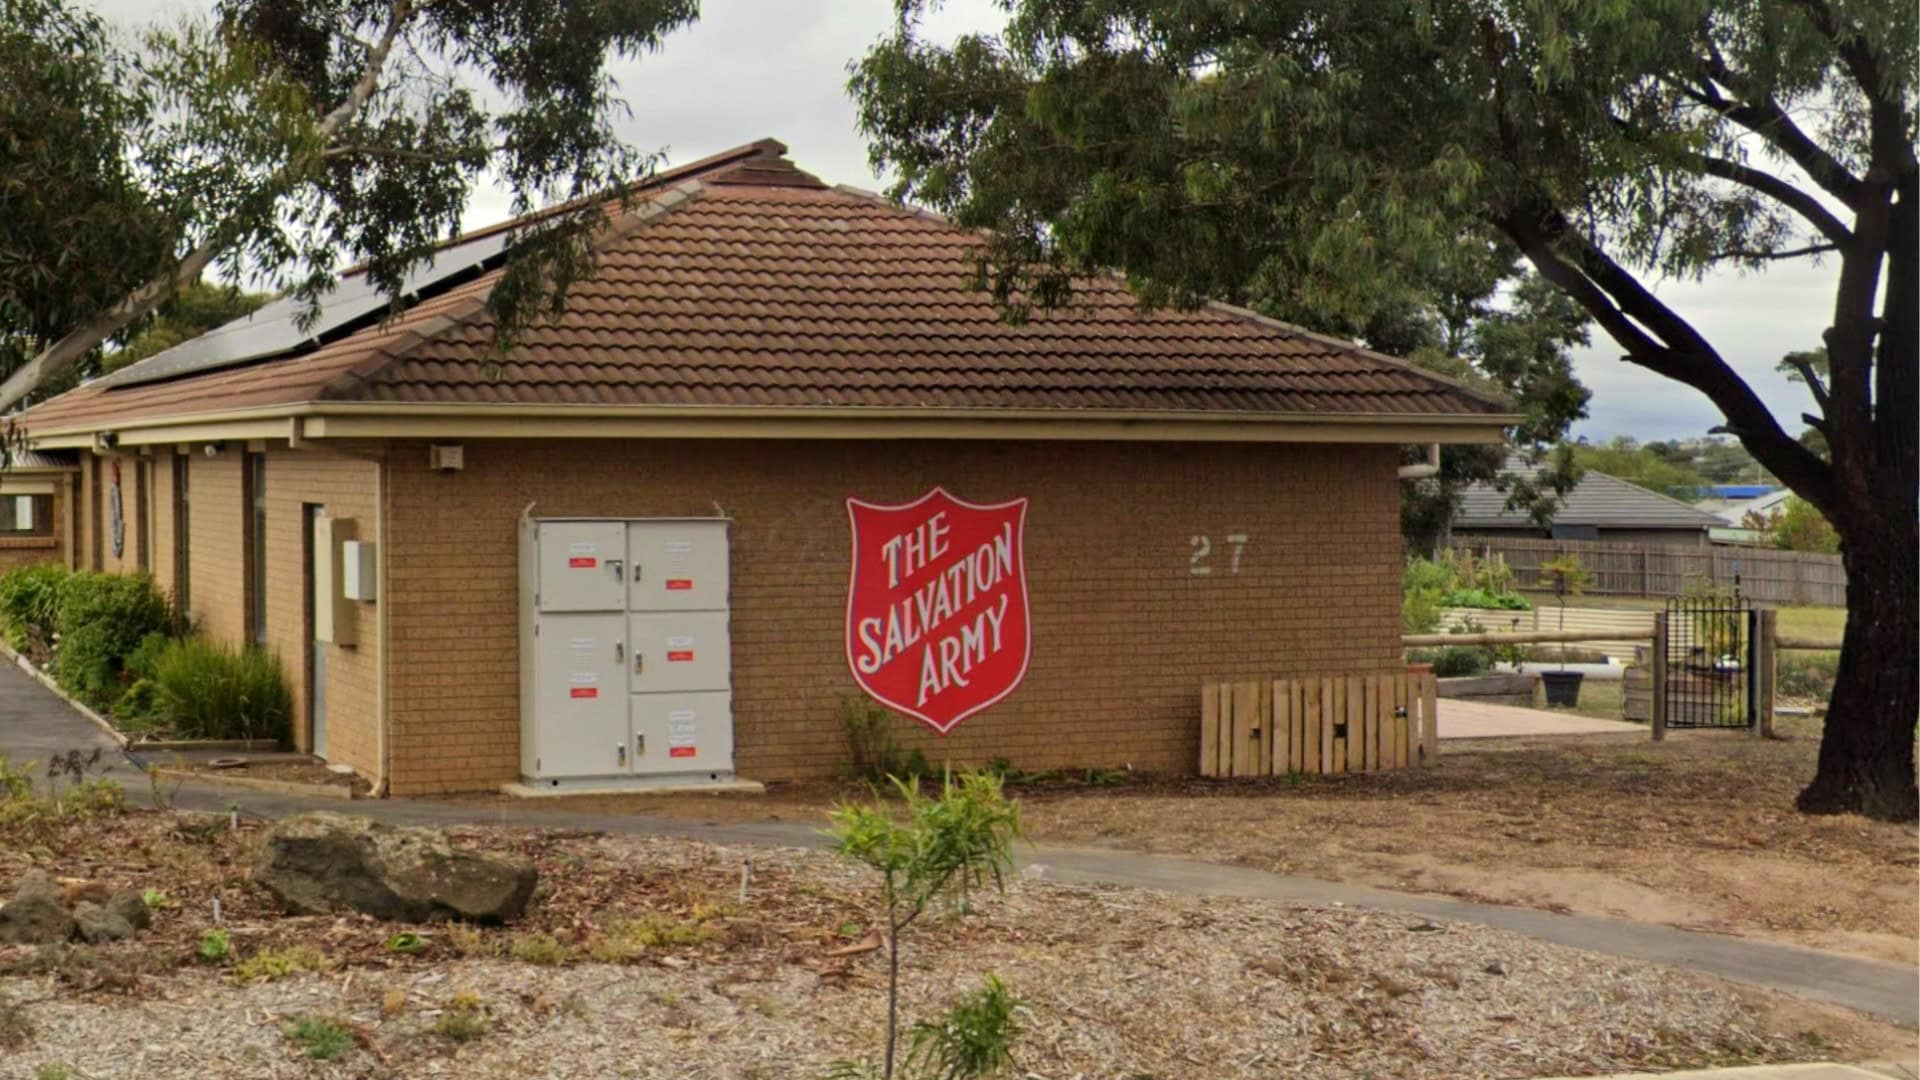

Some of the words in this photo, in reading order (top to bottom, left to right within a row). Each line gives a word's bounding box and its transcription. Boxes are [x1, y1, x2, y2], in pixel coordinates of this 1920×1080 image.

[858, 522, 1013, 674] SALVATION
[882, 511, 950, 590] THE
[1190, 534, 1249, 574] 27
[917, 593, 1009, 708] ARMY
